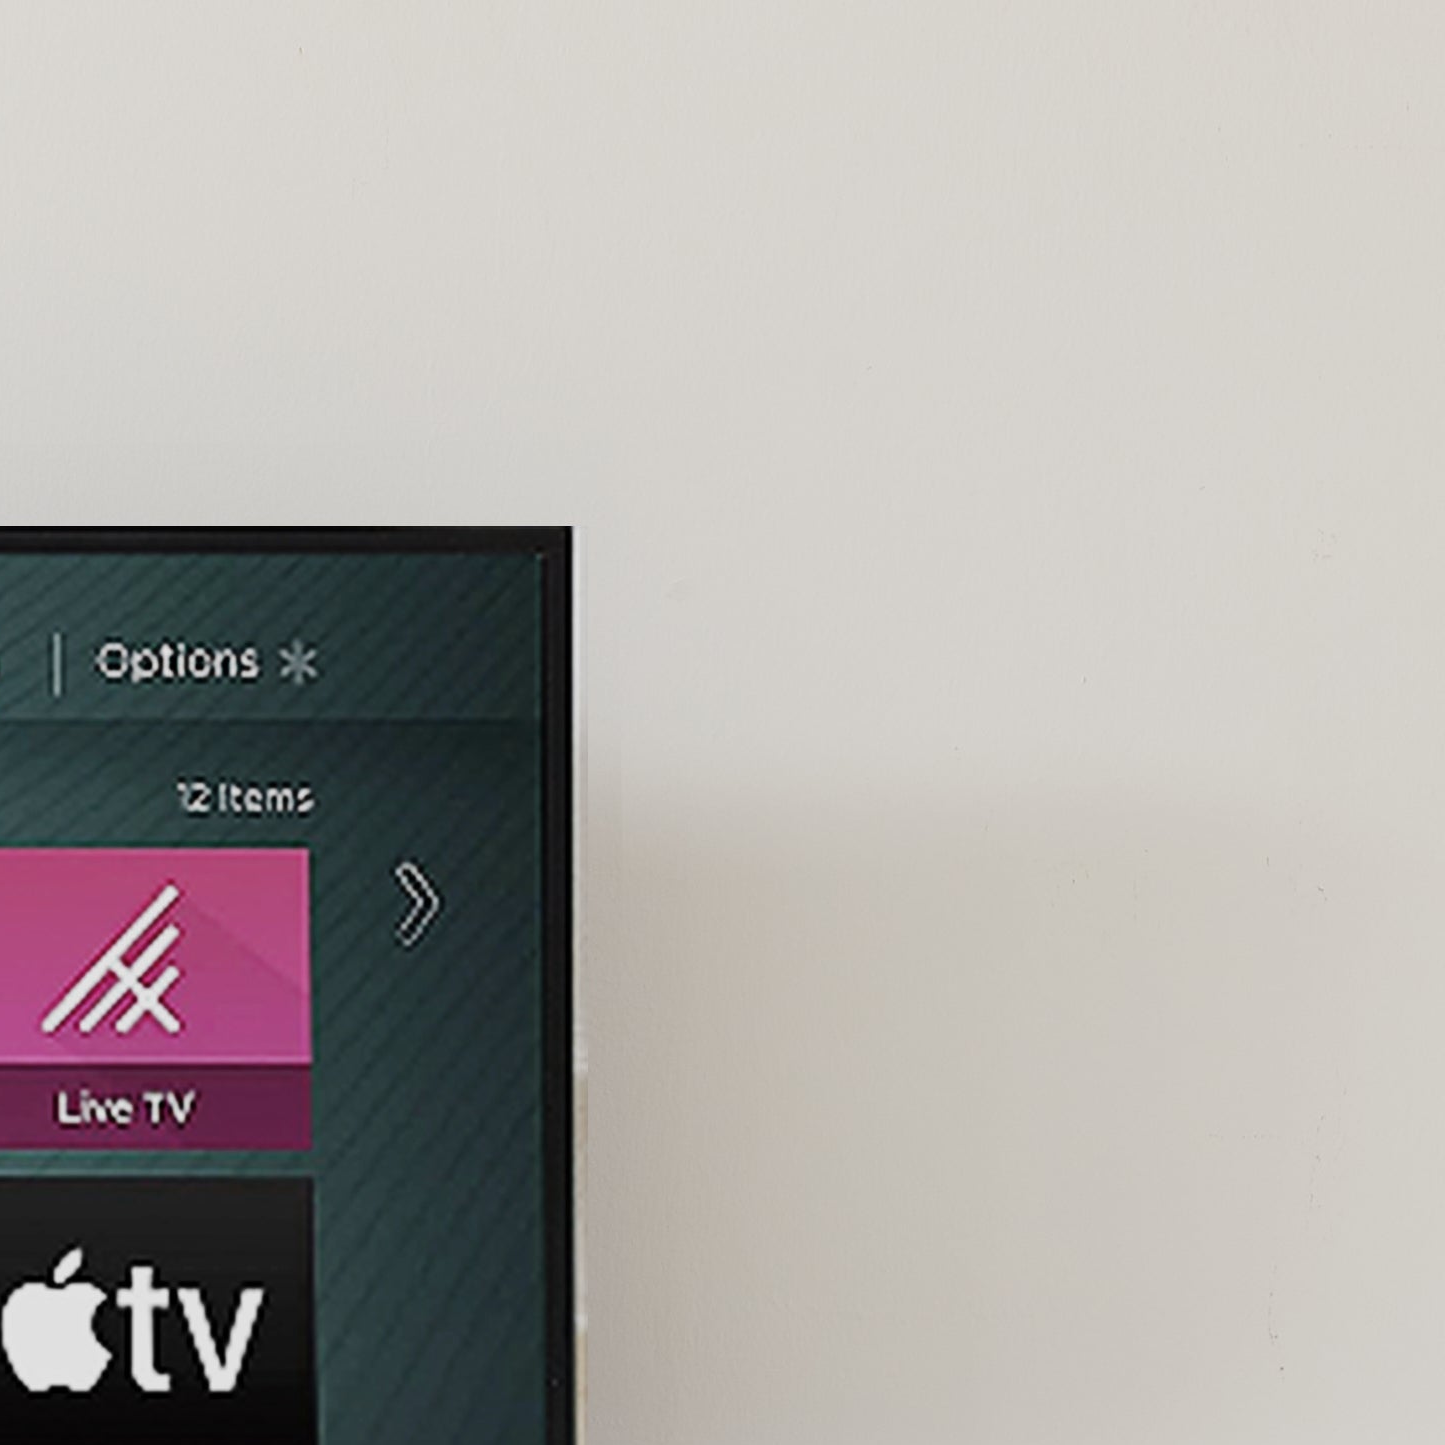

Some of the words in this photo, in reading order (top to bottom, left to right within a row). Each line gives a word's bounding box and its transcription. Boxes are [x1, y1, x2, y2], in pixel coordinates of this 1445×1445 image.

[96, 643, 259, 682] Options
[177, 782, 211, 812] 12
[58, 1090, 133, 1124] Live
[143, 1091, 195, 1123] TV
[116, 1266, 263, 1392] tv
